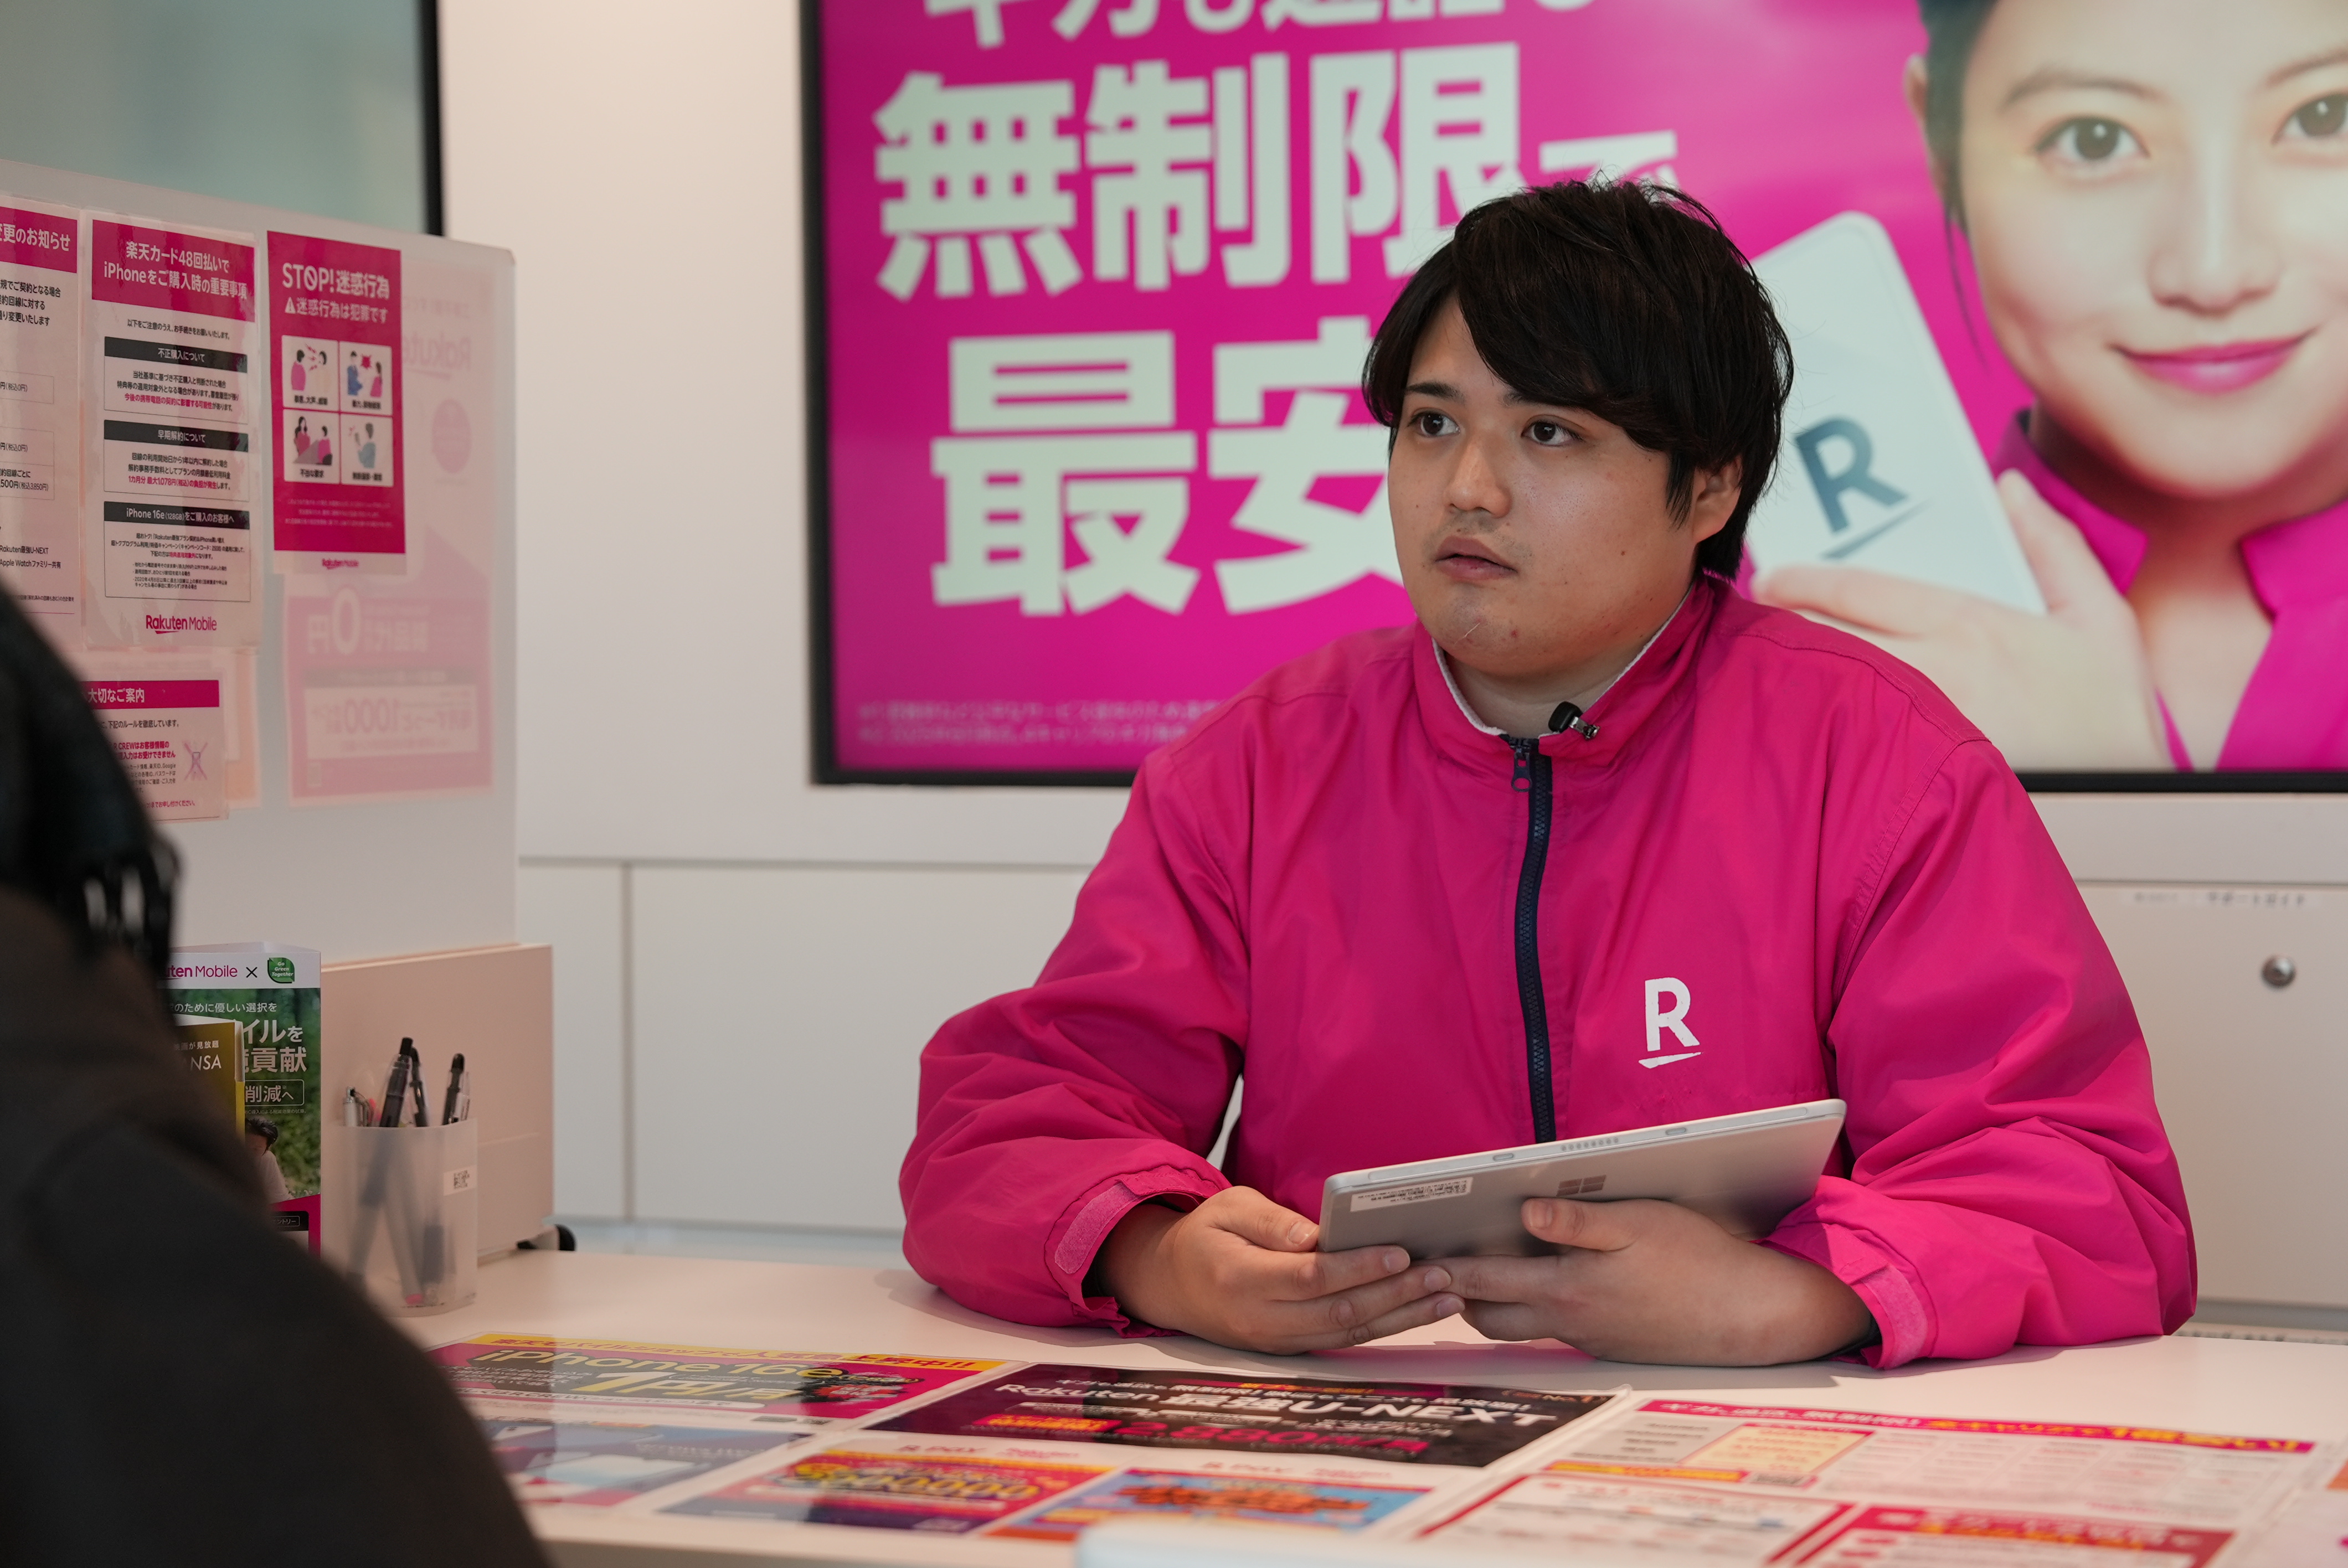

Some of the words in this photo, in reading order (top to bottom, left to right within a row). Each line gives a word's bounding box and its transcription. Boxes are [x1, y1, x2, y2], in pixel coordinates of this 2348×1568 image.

[0, 223, 71, 251] 更のお知らせ
[126, 241, 229, 273] 楽天カード48回払いで
[0, 278, 61, 297] 規でご契約となる場合
[104, 261, 247, 300] iPhoneをご購入時の重要事項
[158, 347, 205, 363] 不正購入について
[158, 429, 206, 443] 早期解約について
[0, 468, 31, 478] 約回線ごとに
[1793, 414, 1911, 534] R
[0, 559, 14, 568] Apple
[146, 615, 188, 632] Rakuten
[189, 616, 218, 631] Mobile
[88, 688, 145, 704] 大切なご案内
[195, 965, 238, 978] Mobile
[170, 1003, 277, 1013] のために優しい選択を
[1645, 977, 1700, 1052] R
[245, 1046, 307, 1073] 貢献
[473, 1350, 719, 1372] iPhone
[730, 1363, 844, 1379] 16e
[995, 1383, 1160, 1401] Rakuten
